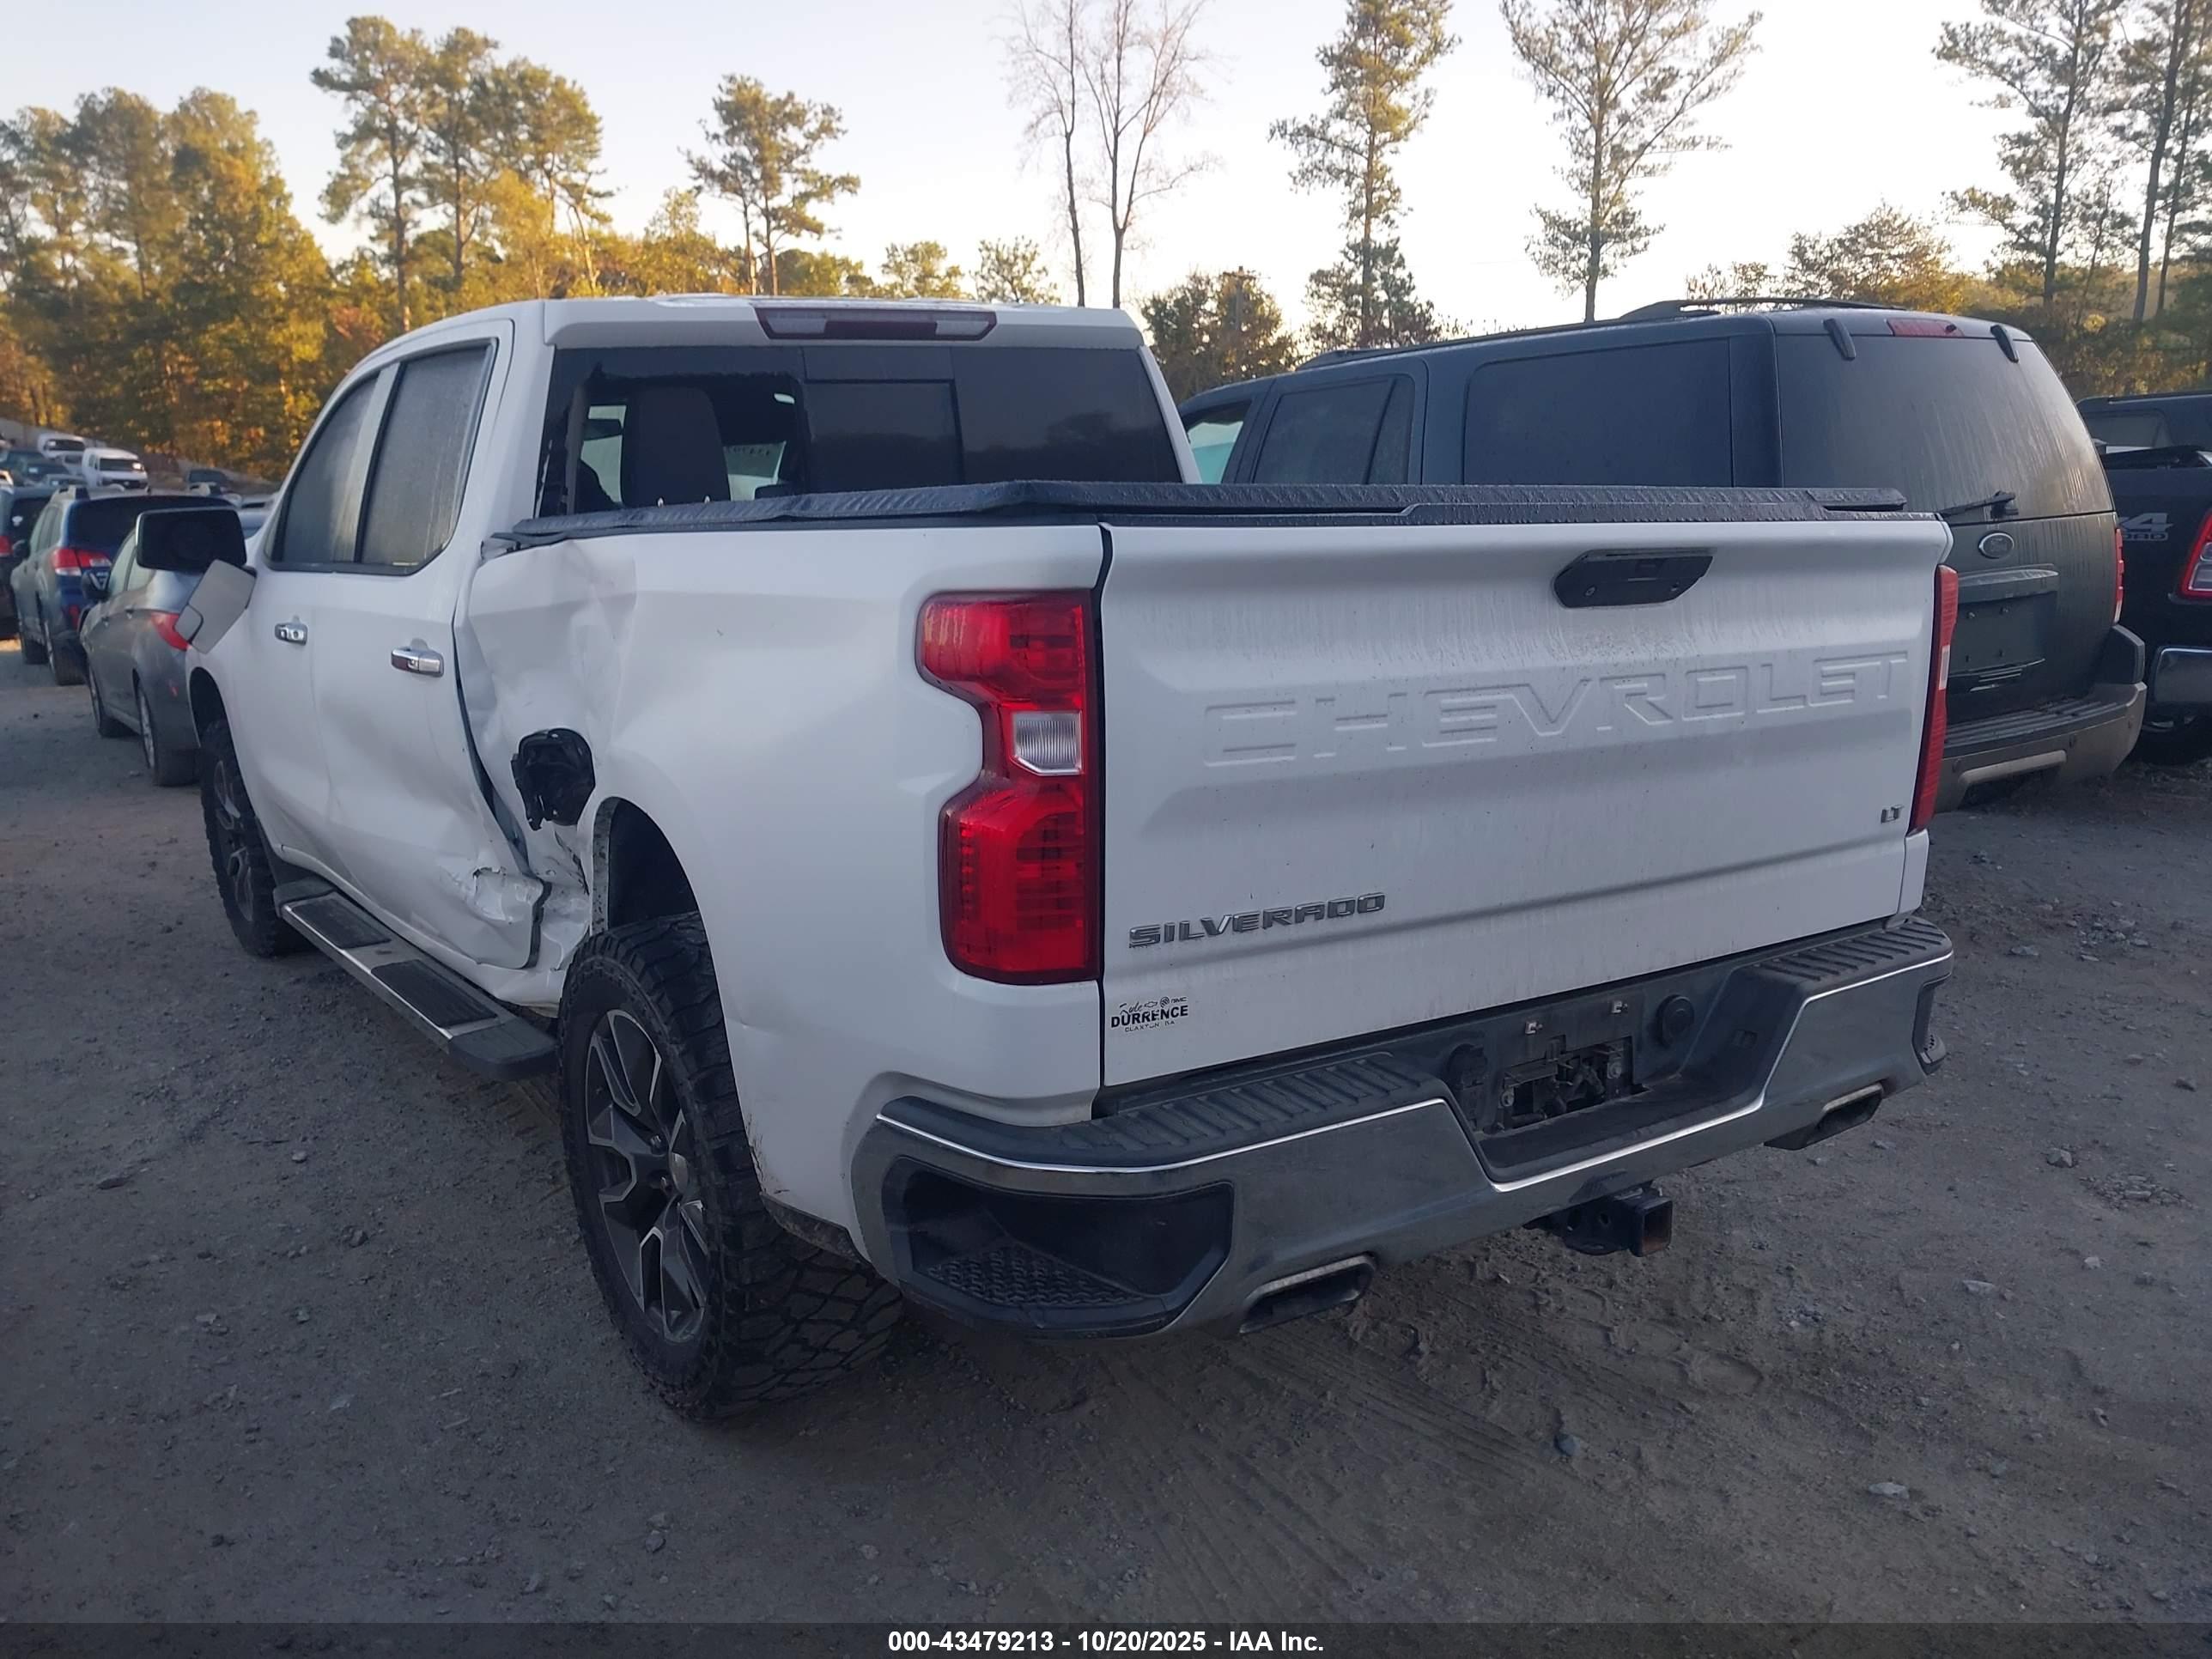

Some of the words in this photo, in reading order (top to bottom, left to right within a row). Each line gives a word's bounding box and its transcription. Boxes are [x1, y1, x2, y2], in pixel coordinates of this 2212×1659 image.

[1204, 650, 1908, 767] CHEVROLET
[1881, 805, 1905, 824] LT
[1128, 891, 1387, 948] SILVERADO
[1110, 1005, 1188, 1029] DURRENCE
